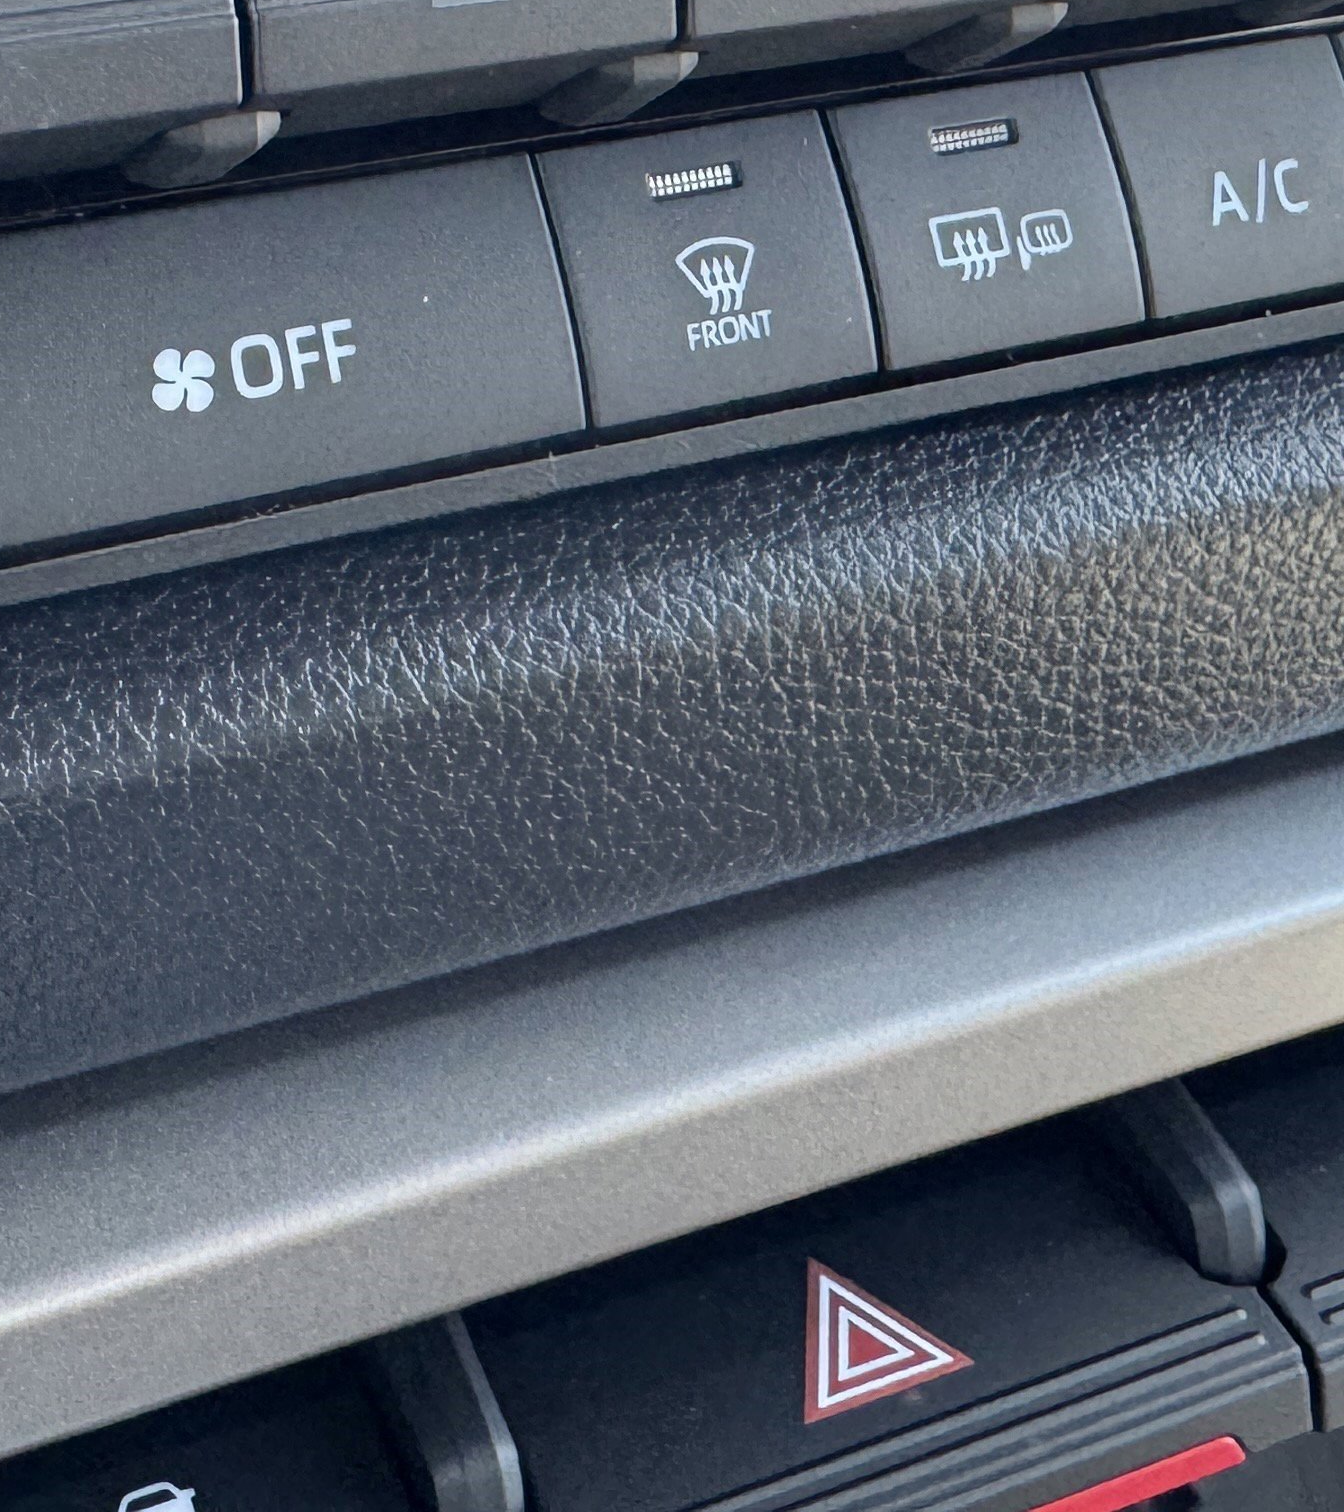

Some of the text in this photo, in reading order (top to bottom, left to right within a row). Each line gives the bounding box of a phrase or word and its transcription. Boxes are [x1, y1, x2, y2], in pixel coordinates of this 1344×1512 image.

[1211, 157, 1311, 228] A/C
[229, 317, 357, 399] OFF
[686, 308, 773, 352] FRONT
